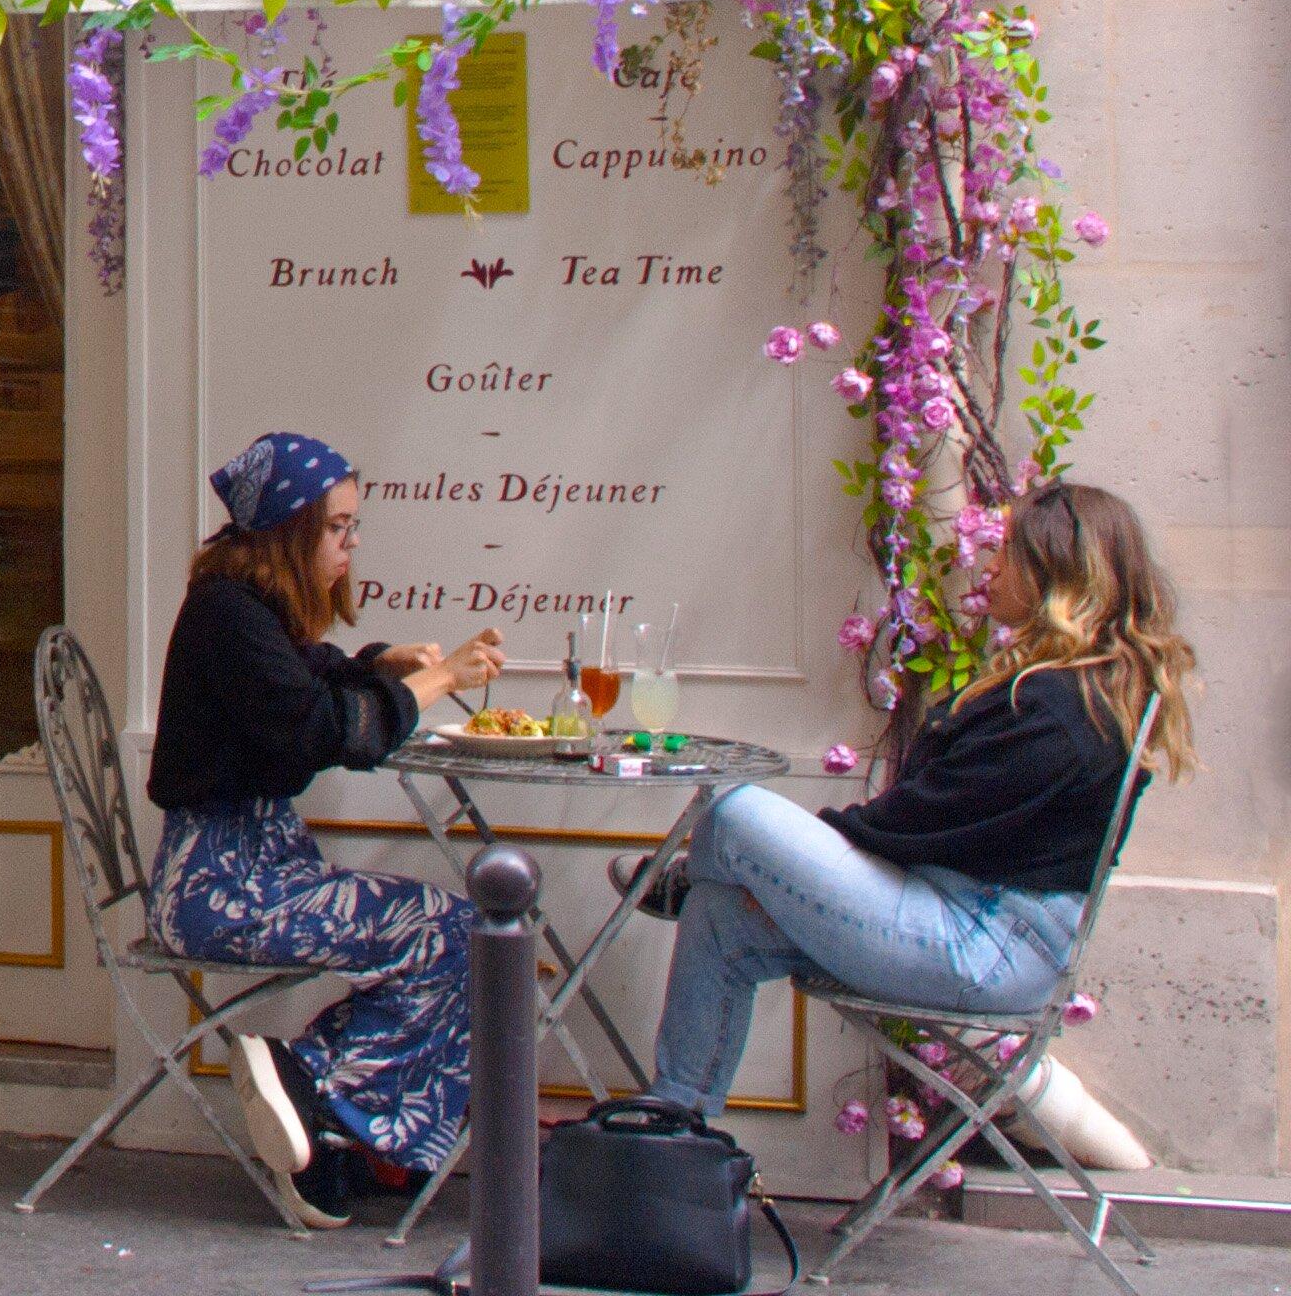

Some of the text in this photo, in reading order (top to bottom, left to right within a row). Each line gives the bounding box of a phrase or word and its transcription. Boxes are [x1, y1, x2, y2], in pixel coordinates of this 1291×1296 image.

[227, 147, 384, 178] Chocolat
[552, 138, 767, 179] Cappuino
[269, 256, 399, 287] Brunch
[561, 255, 724, 286] Tea Time
[425, 362, 553, 393] Goûter
[362, 472, 667, 514] rmules Déjeuner
[356, 580, 635, 624] Petit-Déjeuner
